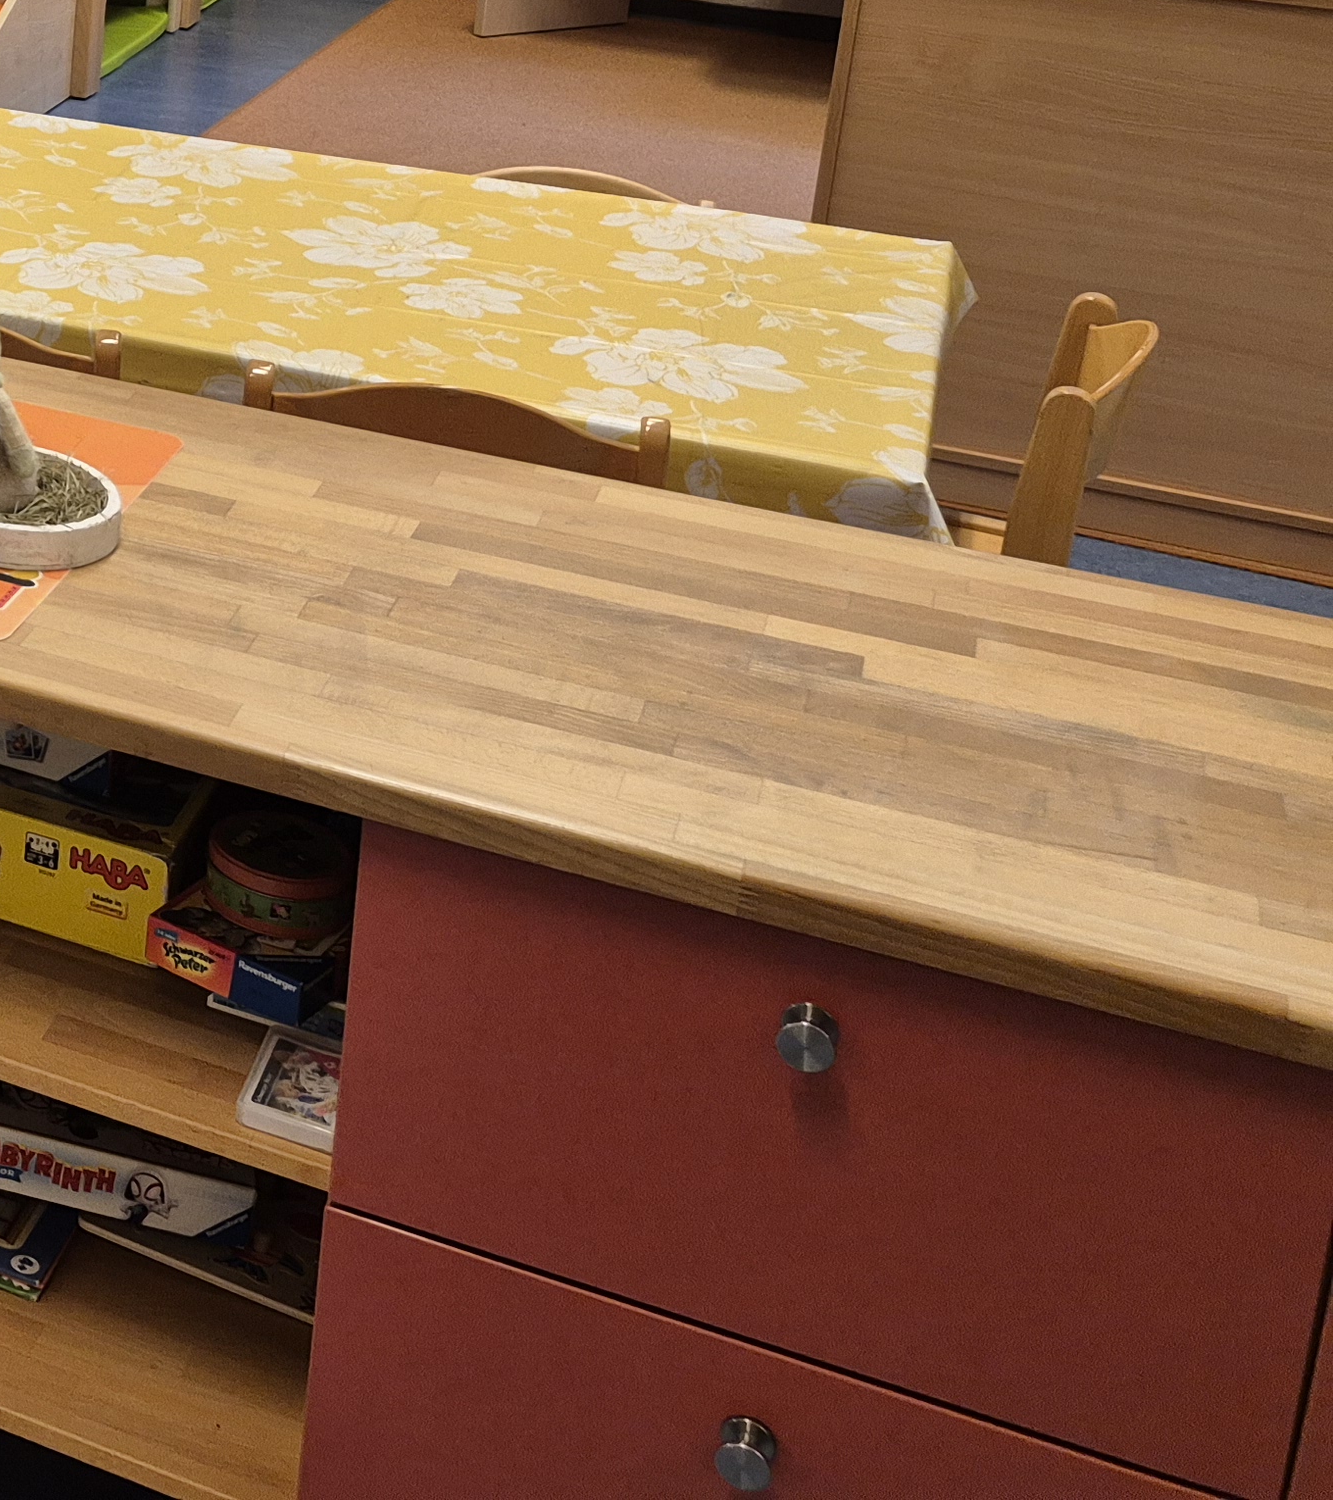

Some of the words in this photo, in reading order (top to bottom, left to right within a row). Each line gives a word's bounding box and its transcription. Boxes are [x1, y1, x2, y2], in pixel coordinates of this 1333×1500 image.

[69, 845, 149, 890] HABA
[173, 953, 209, 975] Peter
[238, 959, 298, 993] Ravensburger
